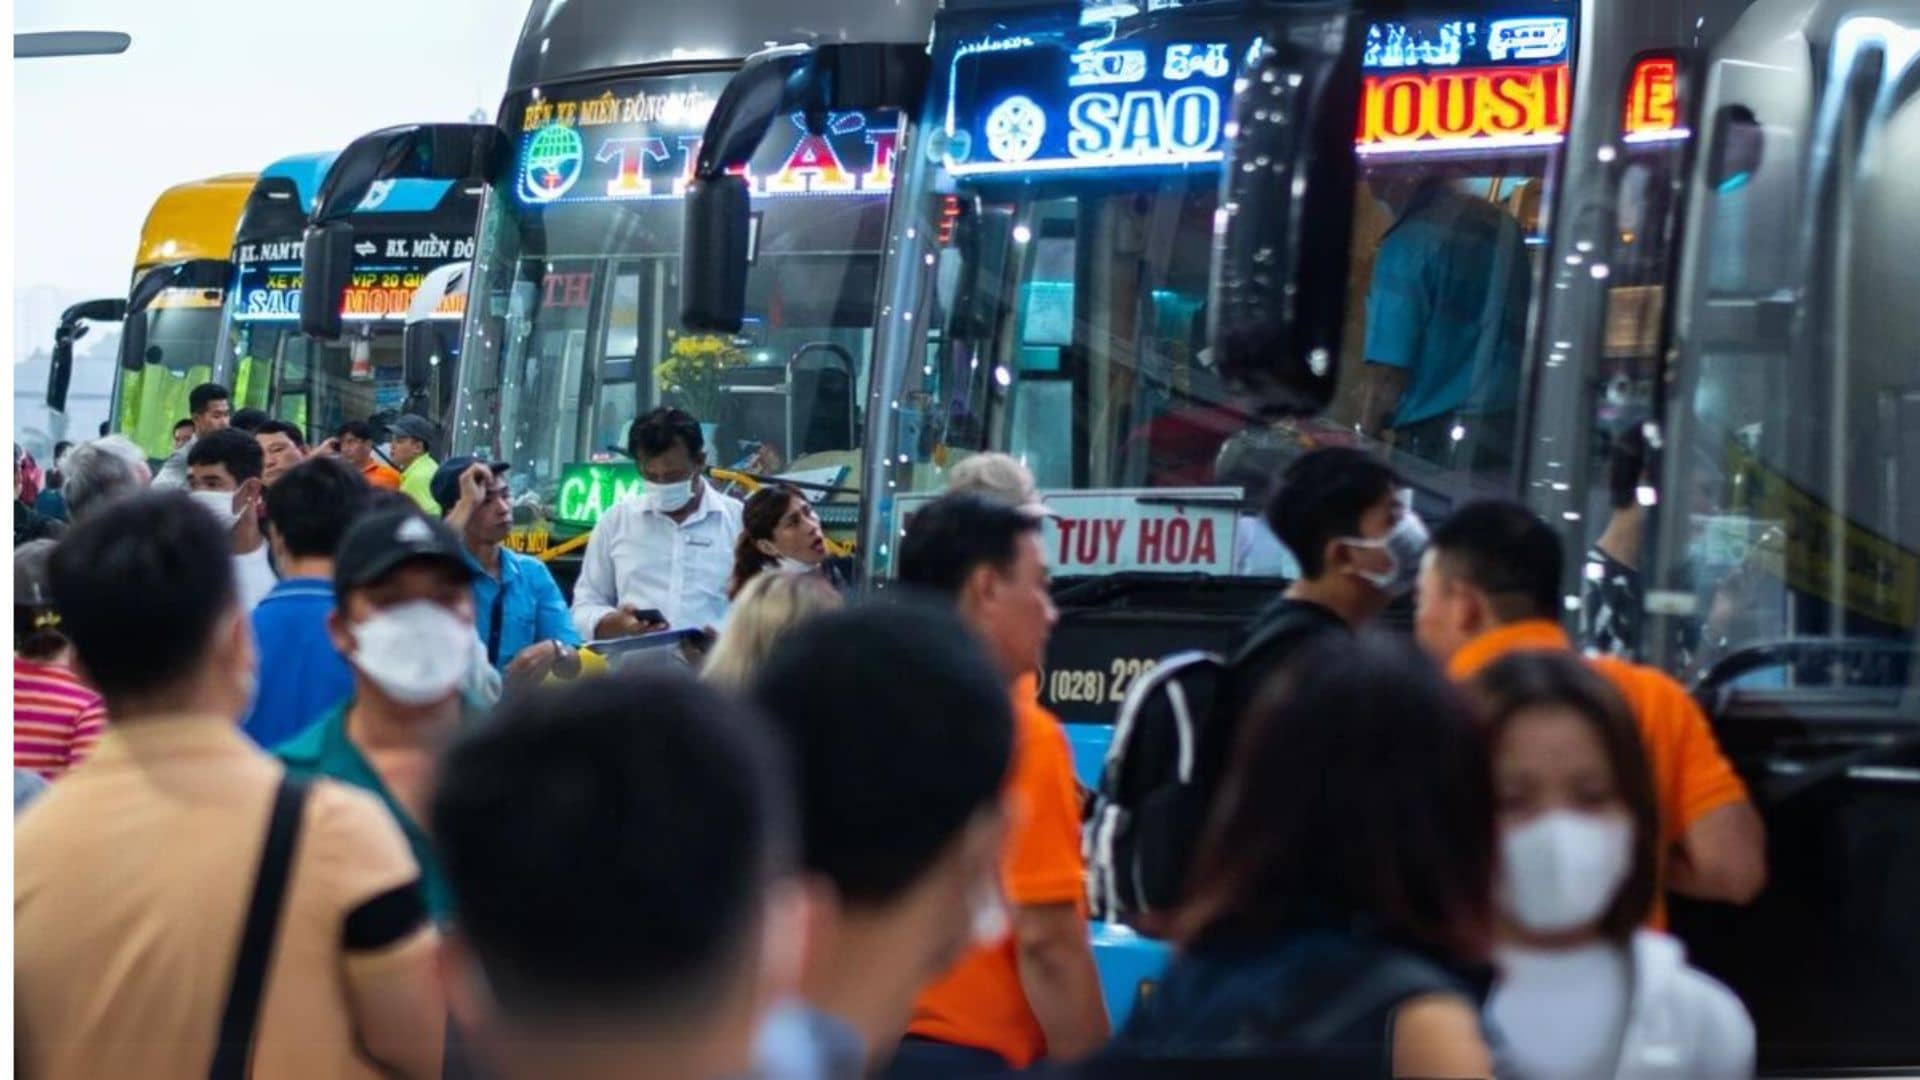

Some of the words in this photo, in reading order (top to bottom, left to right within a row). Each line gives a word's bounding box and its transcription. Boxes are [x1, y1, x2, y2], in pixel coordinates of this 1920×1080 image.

[1068, 86, 1220, 157] SAO
[261, 241, 289, 261] NAM
[386, 239, 409, 258] BX.
[412, 232, 450, 258] MIỀN
[352, 273, 377, 288] VIP
[382, 273, 400, 288] 20
[560, 467, 602, 521] CÀ
[1057, 518, 1126, 566] TUY
[1136, 504, 1217, 566] HÒA
[1050, 669, 1105, 705] (028)
